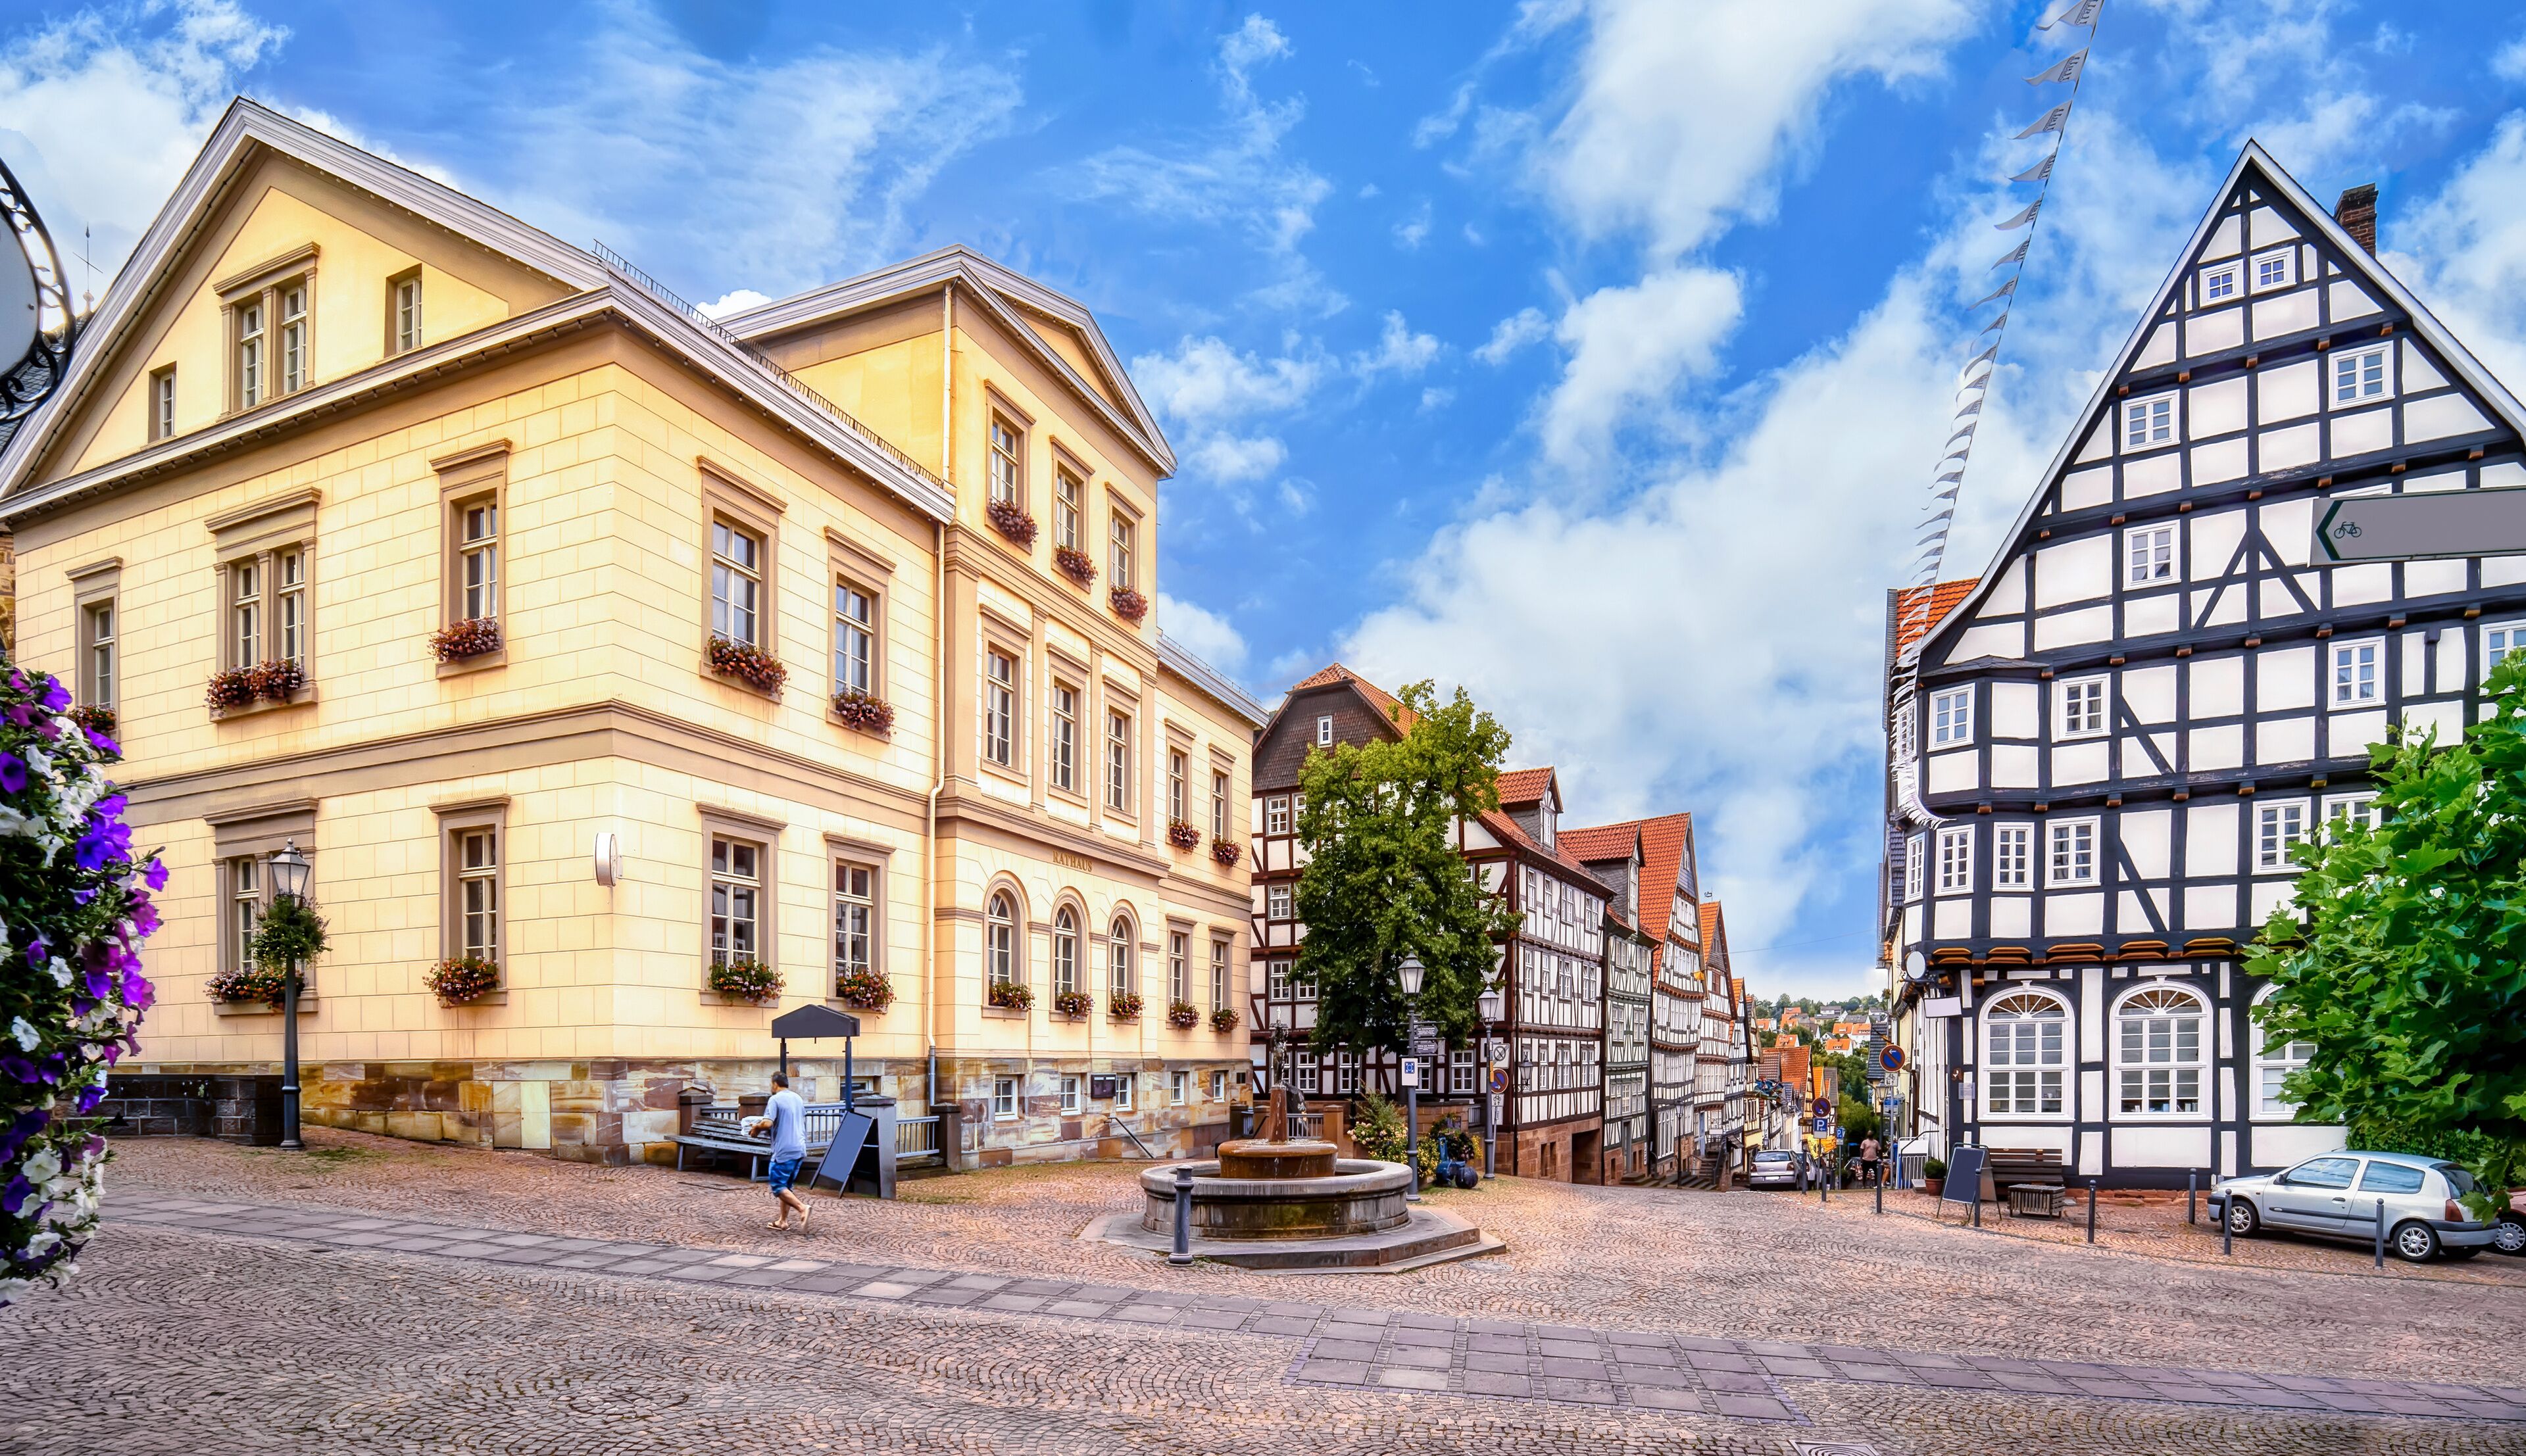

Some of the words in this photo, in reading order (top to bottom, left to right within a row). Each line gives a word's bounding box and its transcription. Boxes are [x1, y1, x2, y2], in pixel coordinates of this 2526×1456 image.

[1052, 851, 1092, 872] RATHAUS
[1817, 1119, 1825, 1131] P
[1837, 1129, 1841, 1138] P
